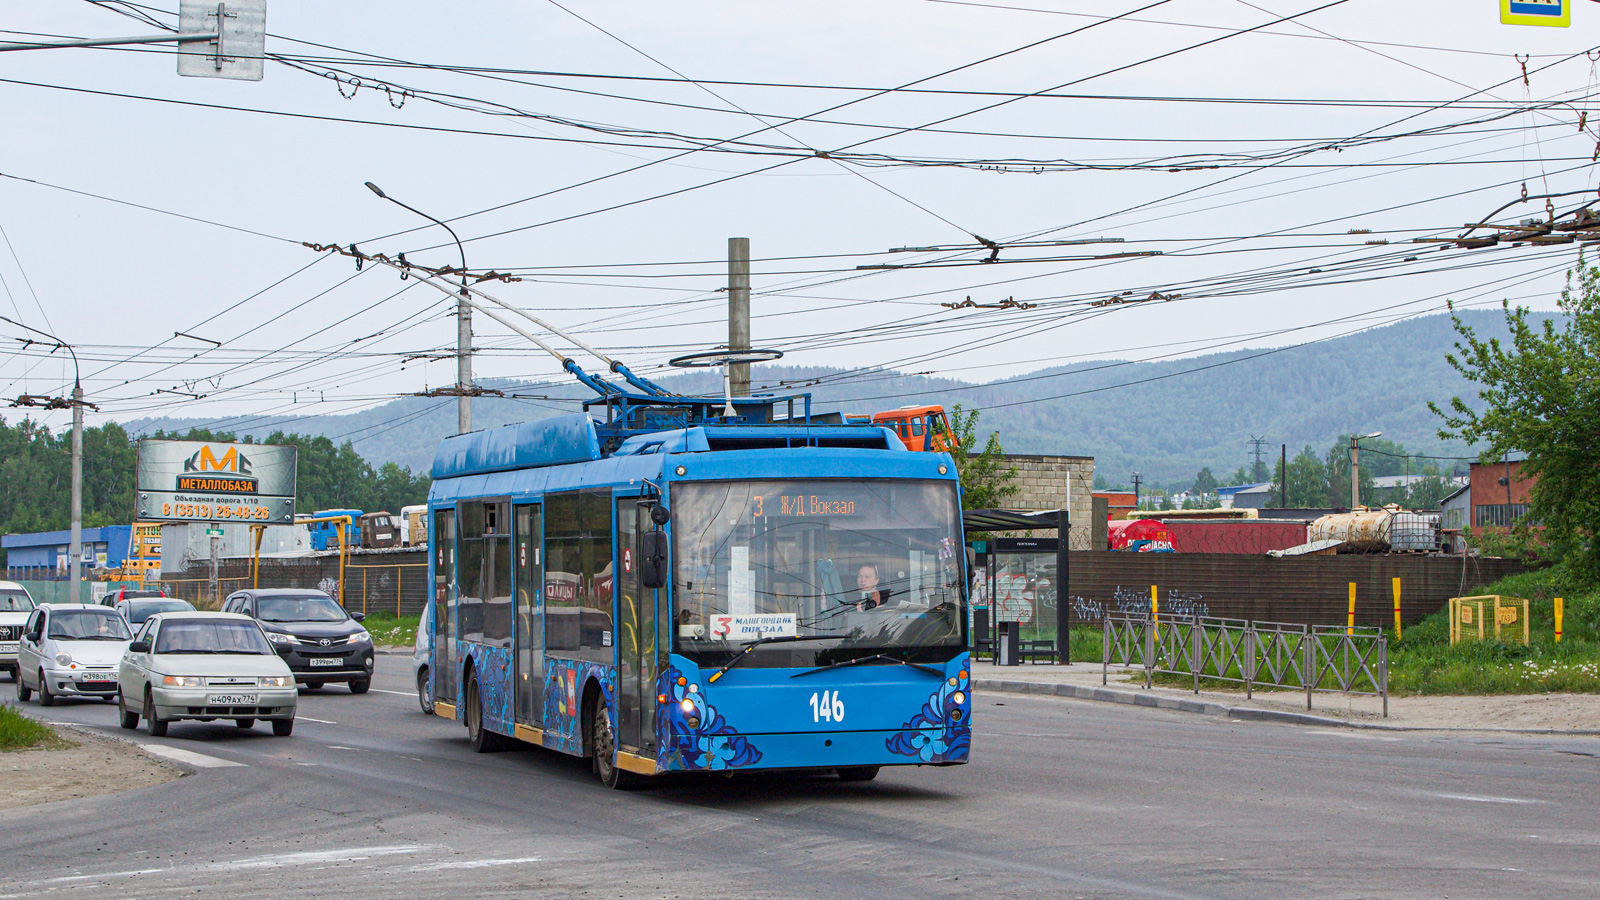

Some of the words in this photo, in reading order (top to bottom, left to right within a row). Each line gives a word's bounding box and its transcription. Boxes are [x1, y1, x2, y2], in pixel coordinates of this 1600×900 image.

[184, 444, 252, 475] КМС
[180, 478, 253, 491] МЕТАЛЛОБАЗА
[174, 495, 214, 503] Объездная
[753, 495, 763, 517] 3
[781, 495, 805, 516] Ж/Д
[810, 495, 855, 514] Вокзал
[162, 503, 170, 516] 8
[173, 503, 212, 519] (3513)
[216, 506, 269, 520] 26-48-26
[713, 617, 732, 637] 3
[809, 690, 845, 723] 146
